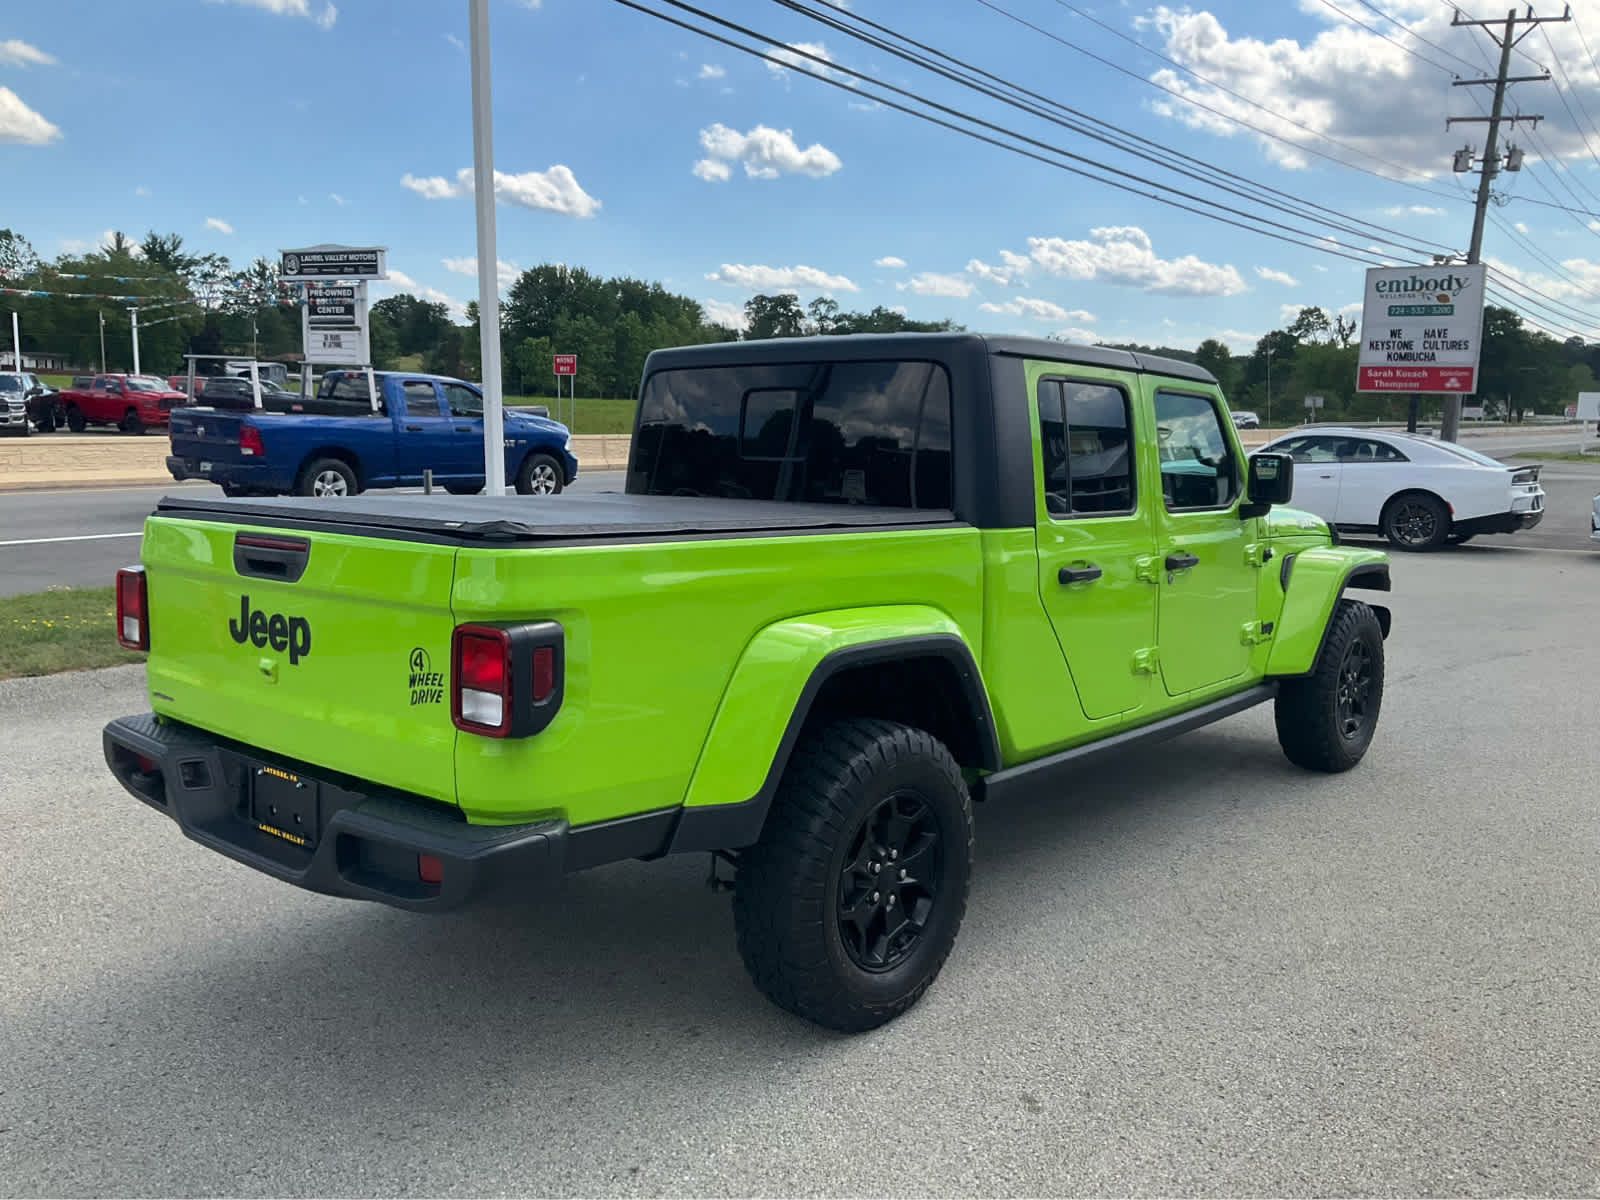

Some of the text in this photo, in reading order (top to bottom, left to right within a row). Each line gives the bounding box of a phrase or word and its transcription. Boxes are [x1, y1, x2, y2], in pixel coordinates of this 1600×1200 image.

[325, 254, 348, 262] VALLEY
[349, 253, 377, 261] MOTORS
[1375, 274, 1472, 297] embody
[309, 289, 353, 297] PRE-OWNED
[316, 306, 345, 314] CENTER
[1390, 328, 1448, 339] WE HAVE
[1368, 340, 1470, 351] KEYSTONE CULTURES
[1386, 351, 1437, 362] KOMBUCHA
[1367, 368, 1394, 378] Sarah
[229, 595, 311, 665] Jeep
[409, 672, 444, 688] WHEEL
[410, 688, 444, 705] DRIVE
